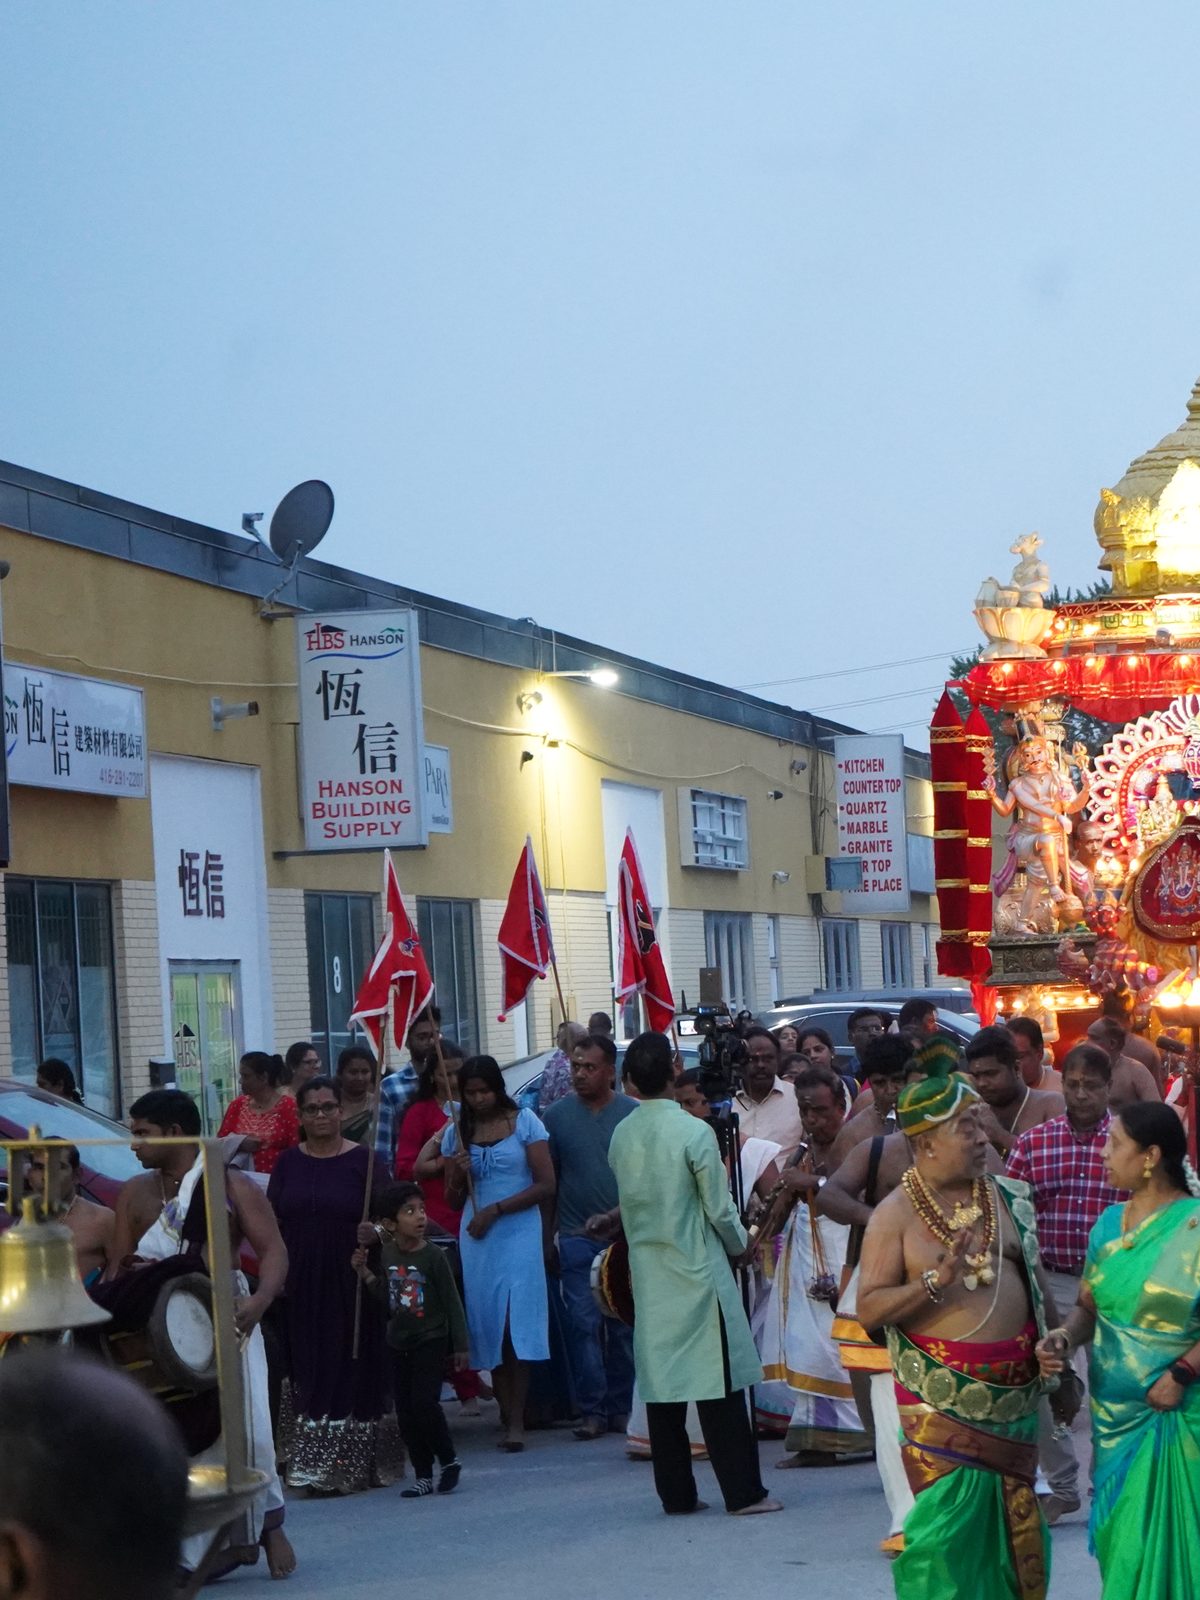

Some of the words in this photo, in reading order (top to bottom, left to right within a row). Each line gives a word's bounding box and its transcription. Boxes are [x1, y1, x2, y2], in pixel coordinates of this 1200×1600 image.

[305, 622, 346, 651] HBS
[350, 633, 404, 647] HANSON
[844, 758, 885, 774] KITCHEN
[318, 779, 403, 799] HANSON
[843, 779, 884, 795] COUNTER
[885, 778, 902, 793] TOP
[312, 800, 412, 820] BUILDING
[846, 801, 887, 816] QUARTZ
[323, 821, 403, 839] SUPPLY
[847, 820, 888, 835] MARBLE
[848, 840, 893, 854] GRANITE
[871, 859, 891, 873] TOP
[872, 878, 902, 892] PLACE
[332, 955, 342, 994] 8
